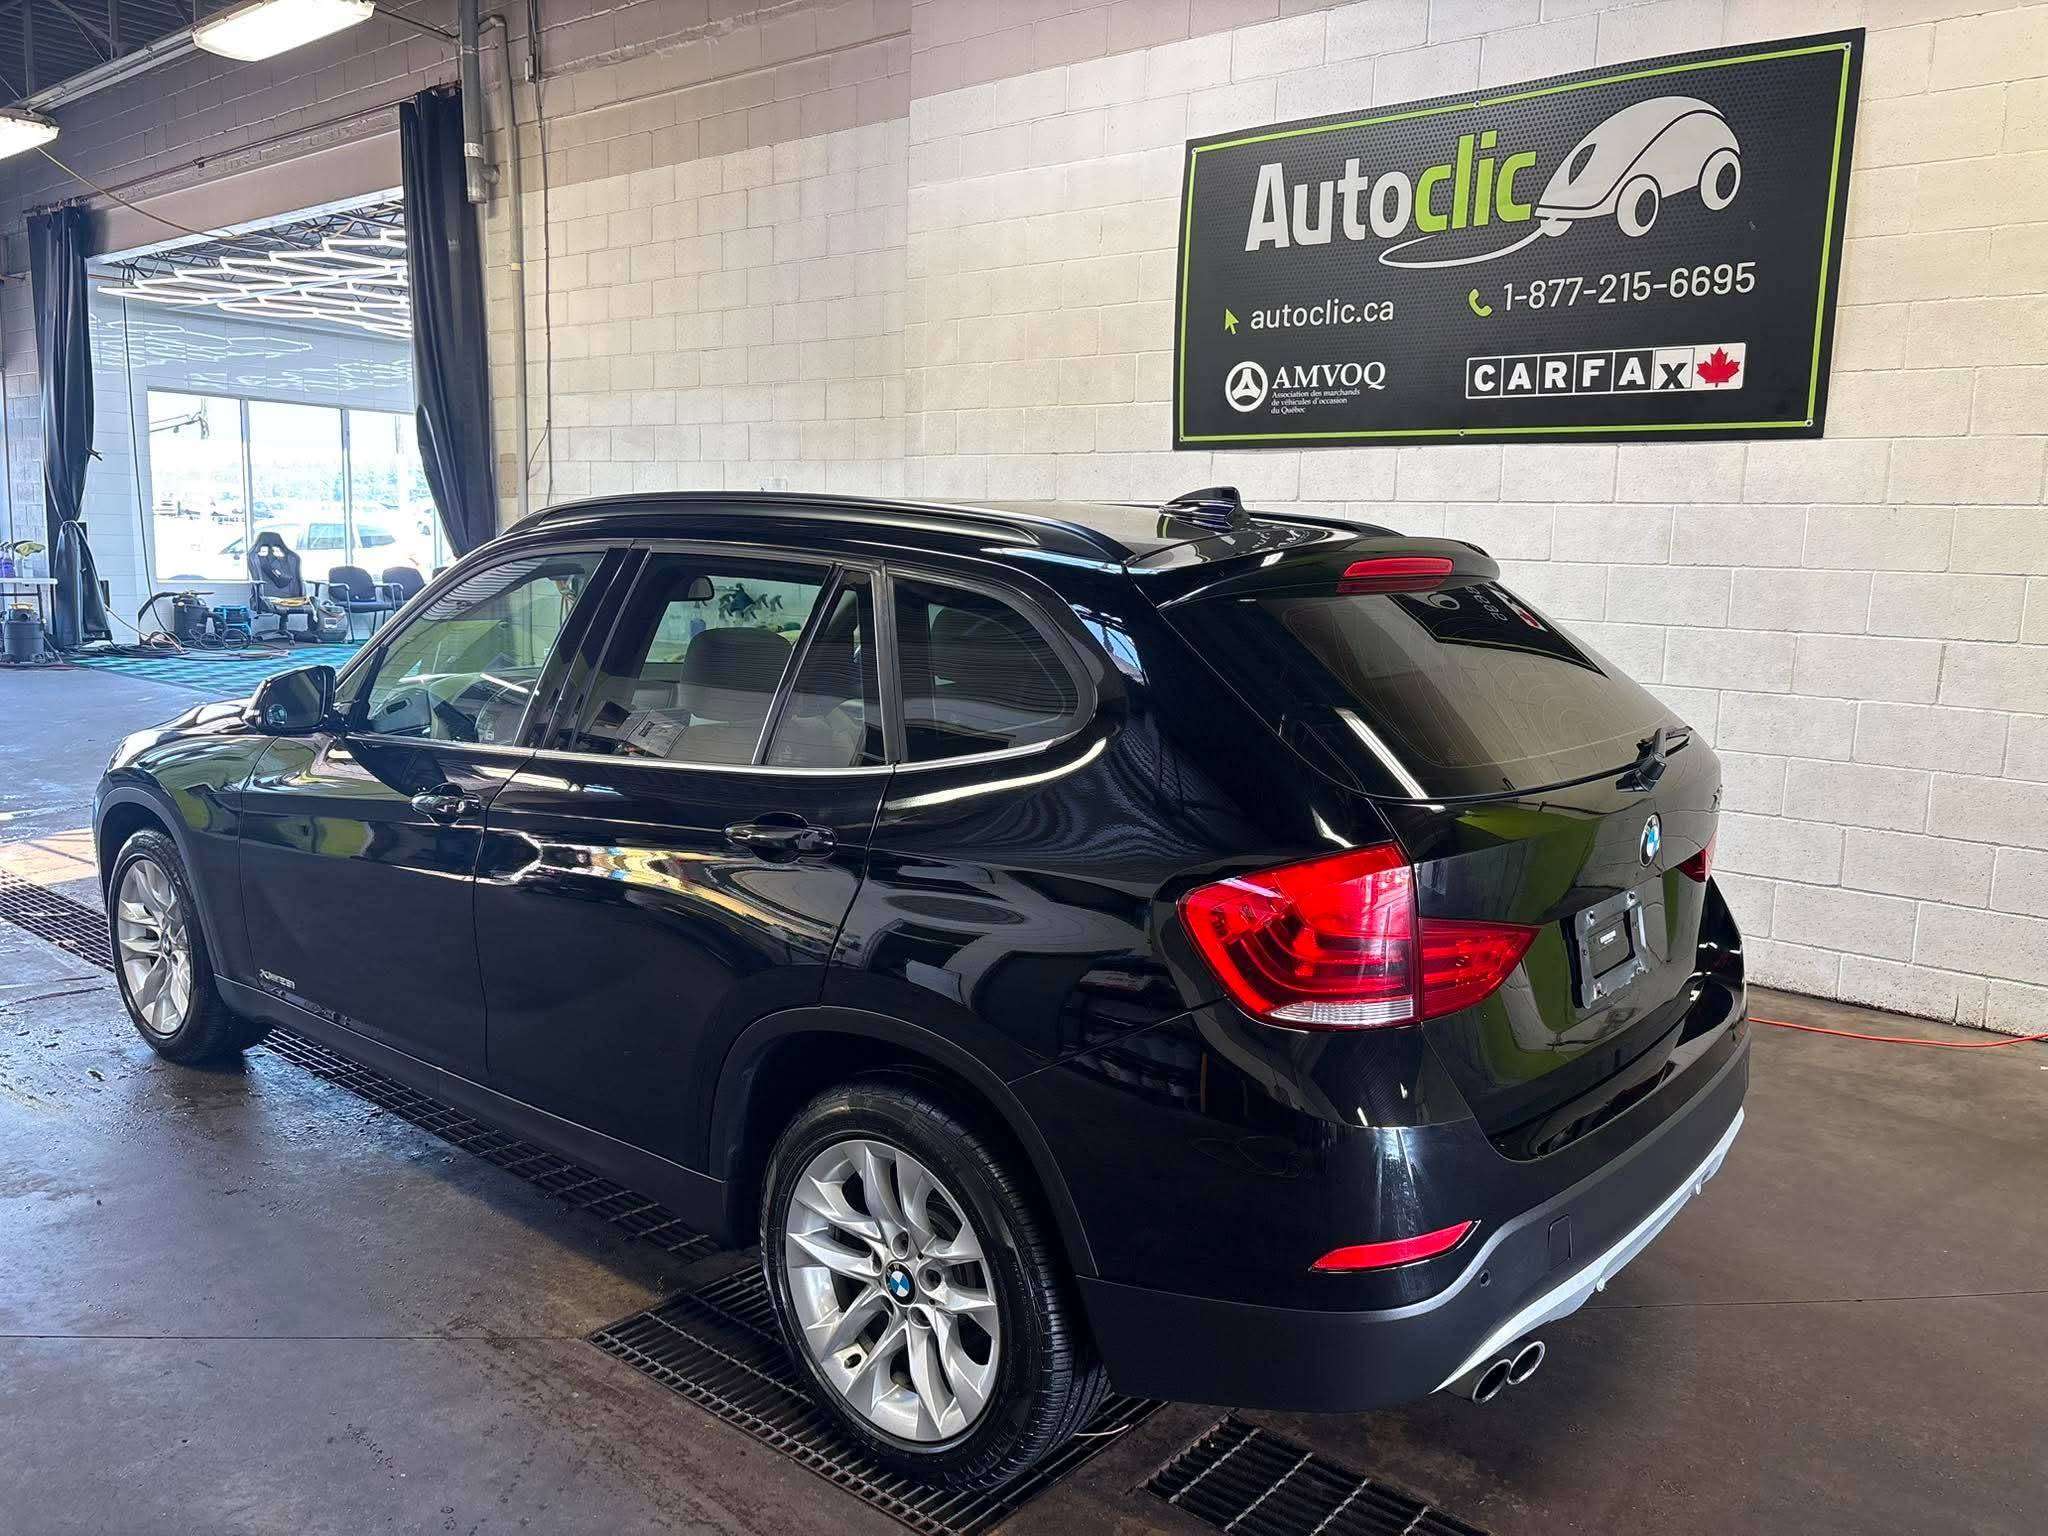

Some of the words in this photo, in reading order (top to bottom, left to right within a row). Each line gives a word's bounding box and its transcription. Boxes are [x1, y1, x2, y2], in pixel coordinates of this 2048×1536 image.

[1245, 131, 1537, 252] Autoclic
[1503, 261, 1757, 311] 1-877-215-6695
[1250, 298, 1395, 330] autoclic.ca
[1271, 362, 1386, 390] AMVOQ
[1474, 357, 1688, 392] CARFAX
[1271, 391, 1310, 399] Association
[1323, 388, 1361, 397] marchands
